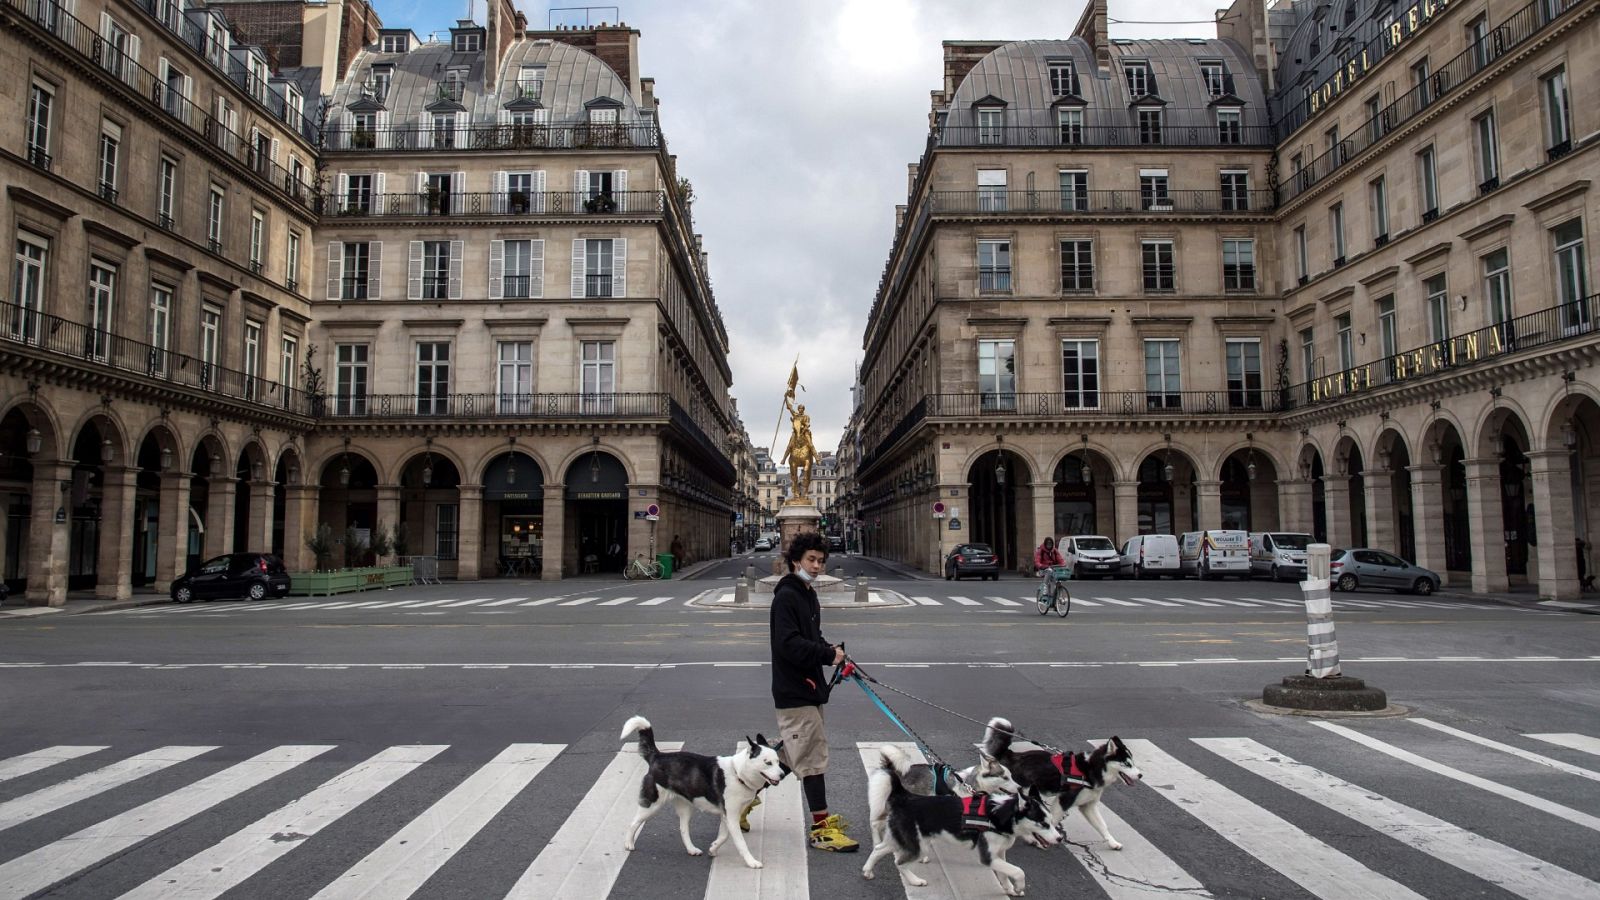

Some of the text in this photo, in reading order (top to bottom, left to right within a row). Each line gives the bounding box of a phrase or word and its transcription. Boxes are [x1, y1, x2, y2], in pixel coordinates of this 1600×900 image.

[1311, 0, 1449, 112] HOTEL REG
[1312, 326, 1501, 401] HOTEL REGINA
